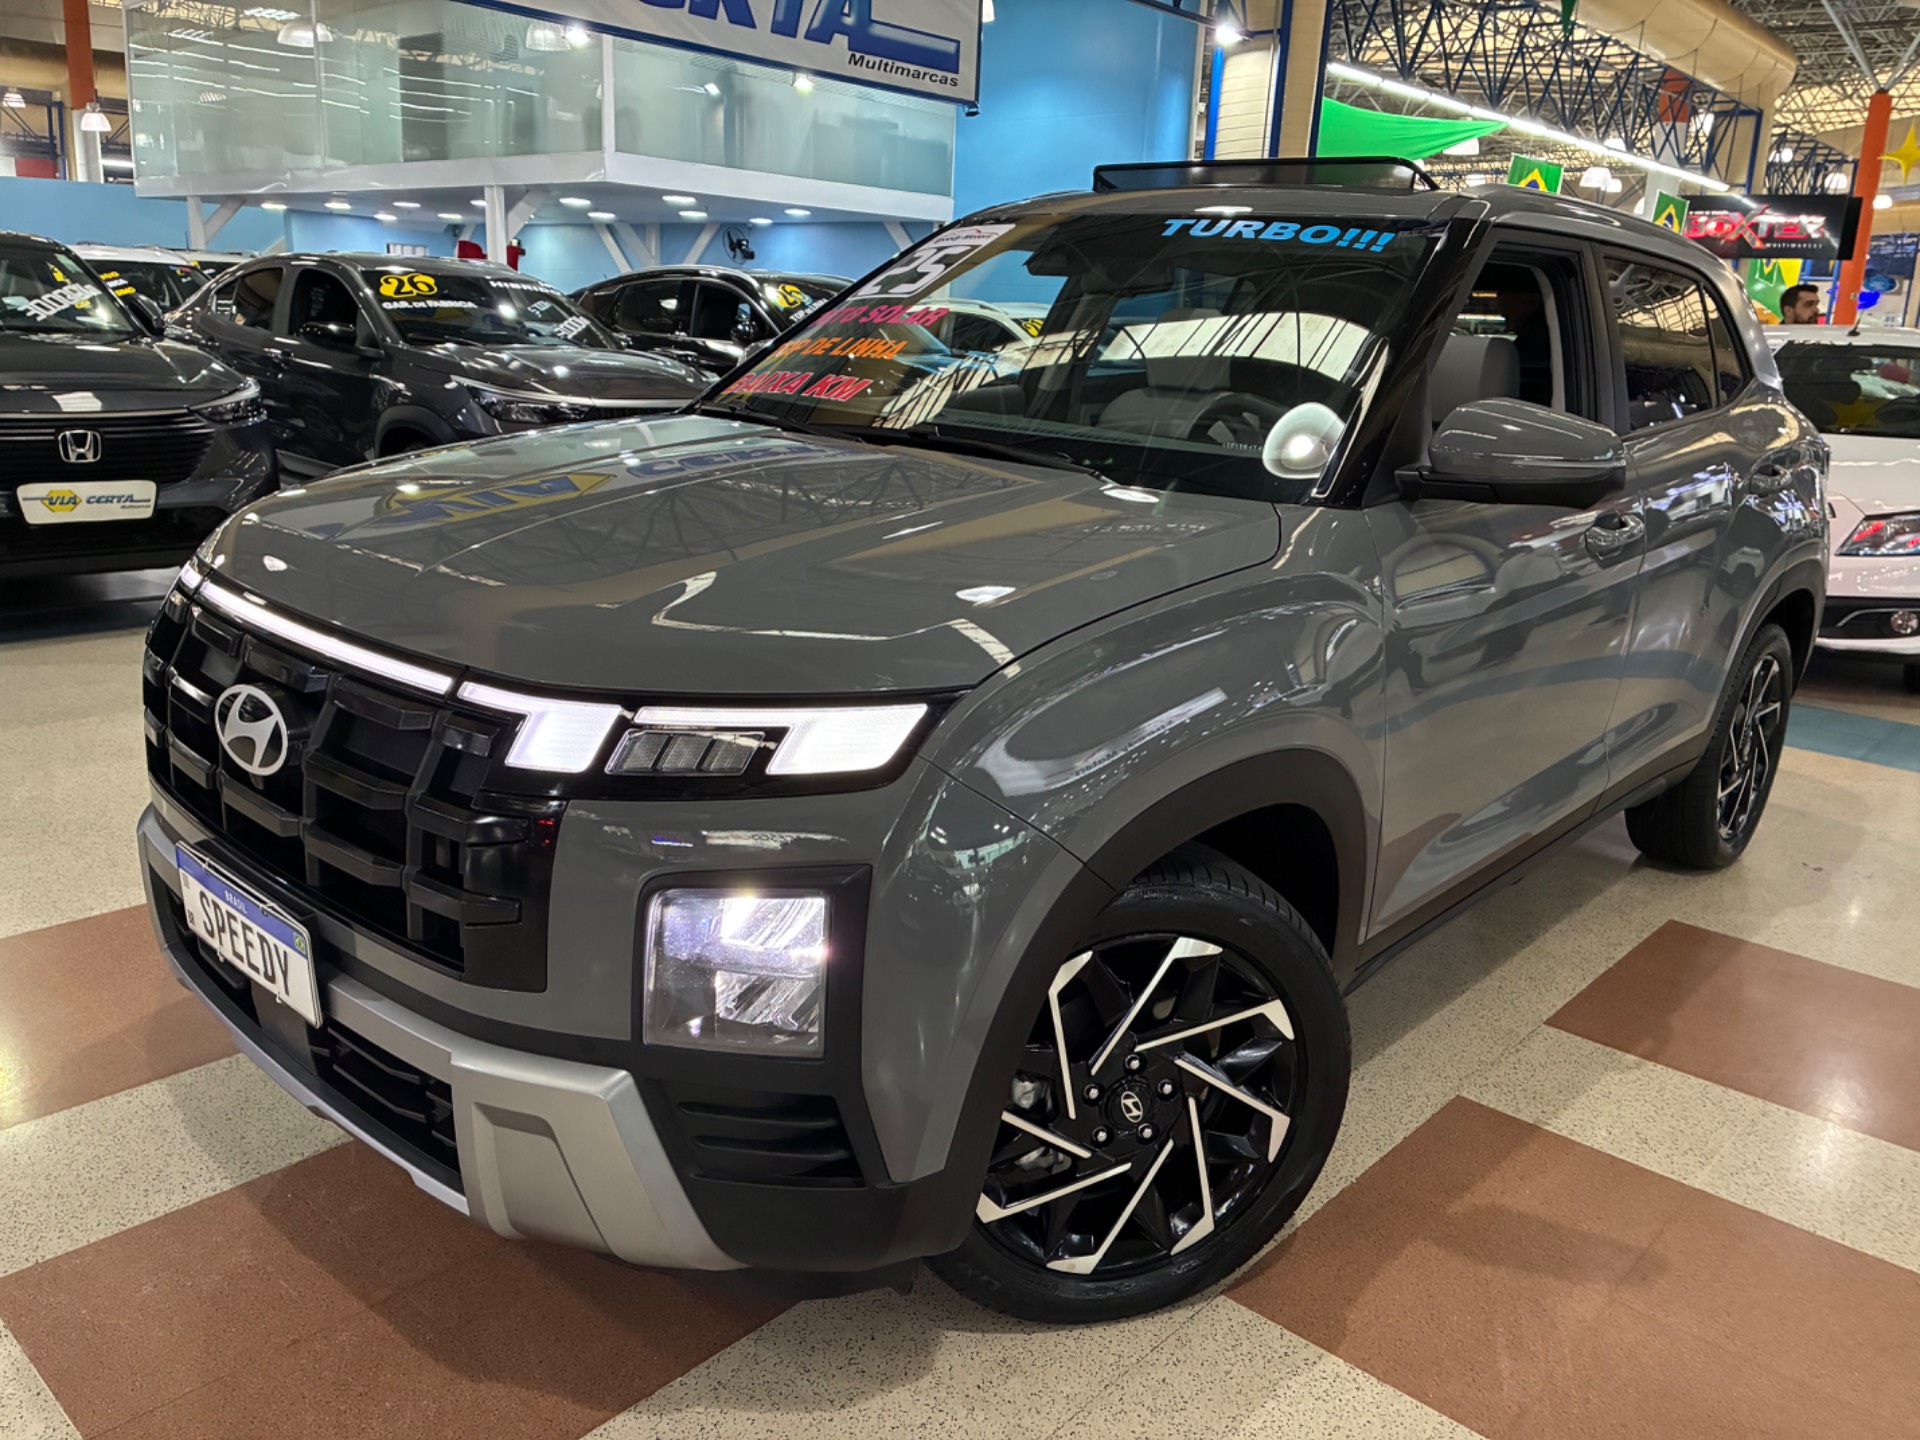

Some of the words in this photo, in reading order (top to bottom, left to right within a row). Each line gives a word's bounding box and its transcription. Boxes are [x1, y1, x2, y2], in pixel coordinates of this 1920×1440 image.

[848, 53, 960, 88] Multimarcas
[1161, 219, 1396, 253] TURBO!!!
[1685, 203, 1826, 249] BOXTER
[382, 274, 436, 296] 26
[857, 246, 972, 296] 25
[859, 304, 950, 327] SOLAR
[800, 337, 843, 356] DE
[828, 337, 908, 360] LINHA
[721, 371, 814, 395] BAIXA
[801, 374, 873, 402] KM
[47, 495, 78, 505] VIA
[86, 494, 141, 504] CERTA
[224, 890, 248, 914] BRASIL
[199, 890, 290, 997] SPEEDY
